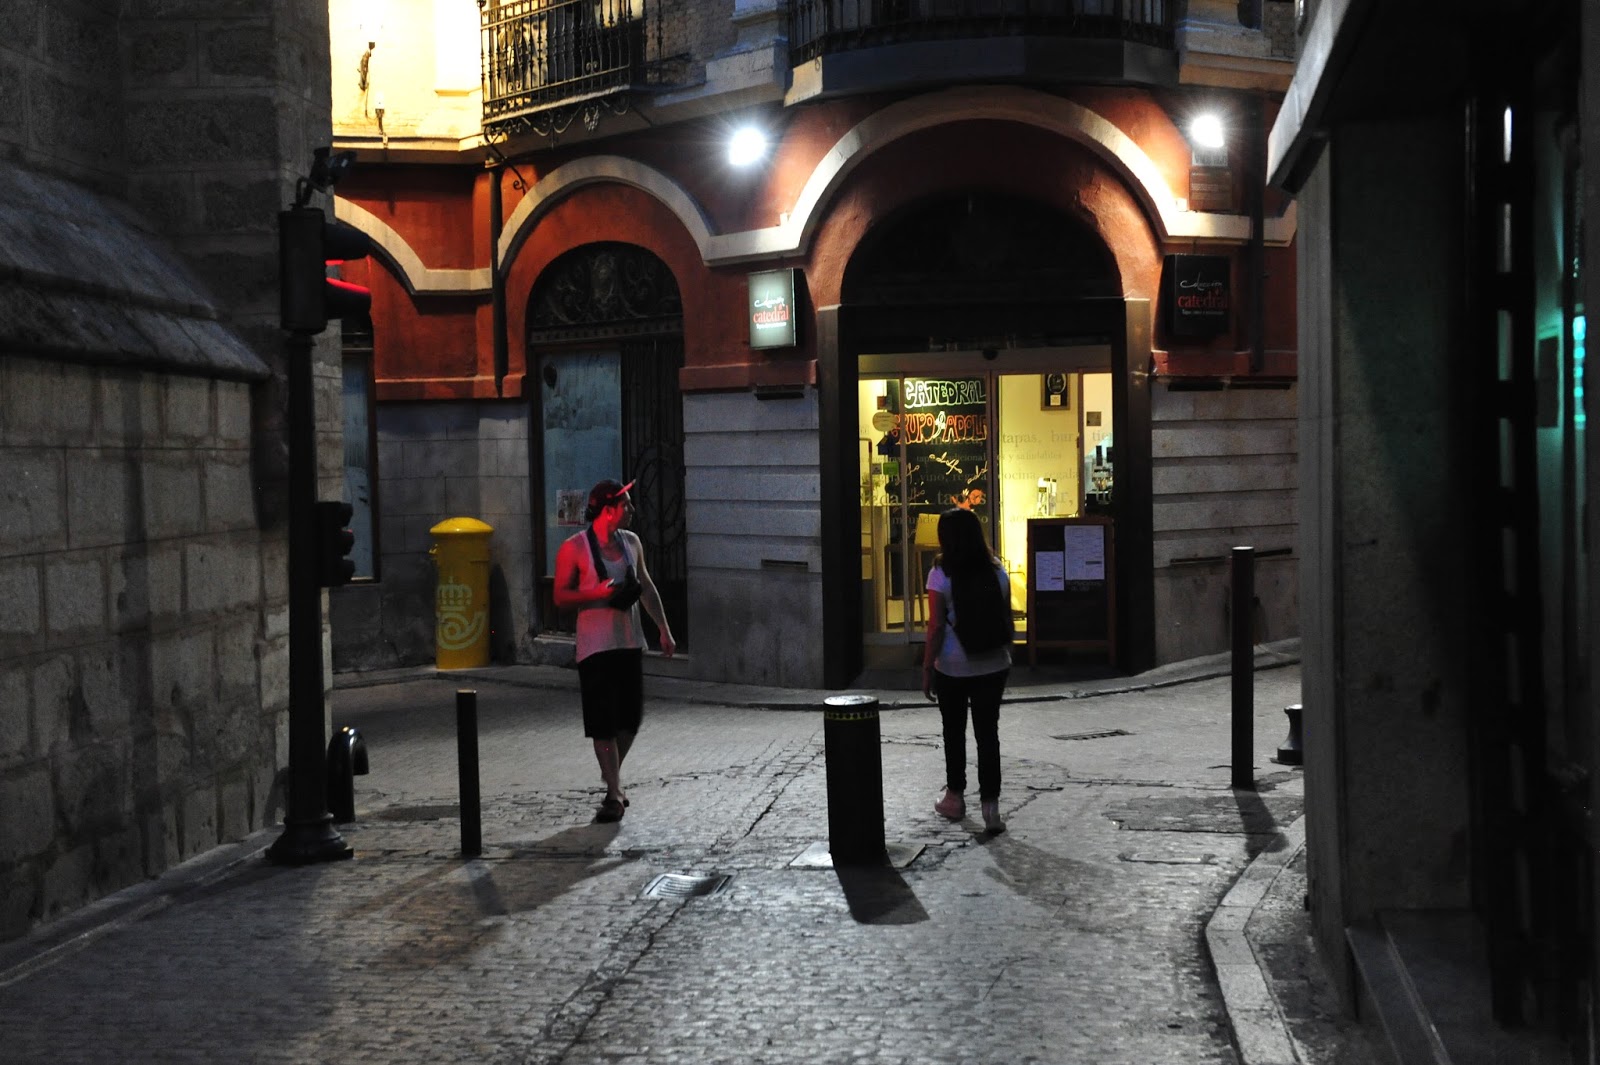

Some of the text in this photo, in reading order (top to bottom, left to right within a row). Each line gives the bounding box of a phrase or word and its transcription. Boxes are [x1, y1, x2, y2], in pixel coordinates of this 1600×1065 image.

[753, 304, 789, 323] catedral
[904, 380, 987, 408] CATEDRAL
[937, 489, 987, 508] taps
